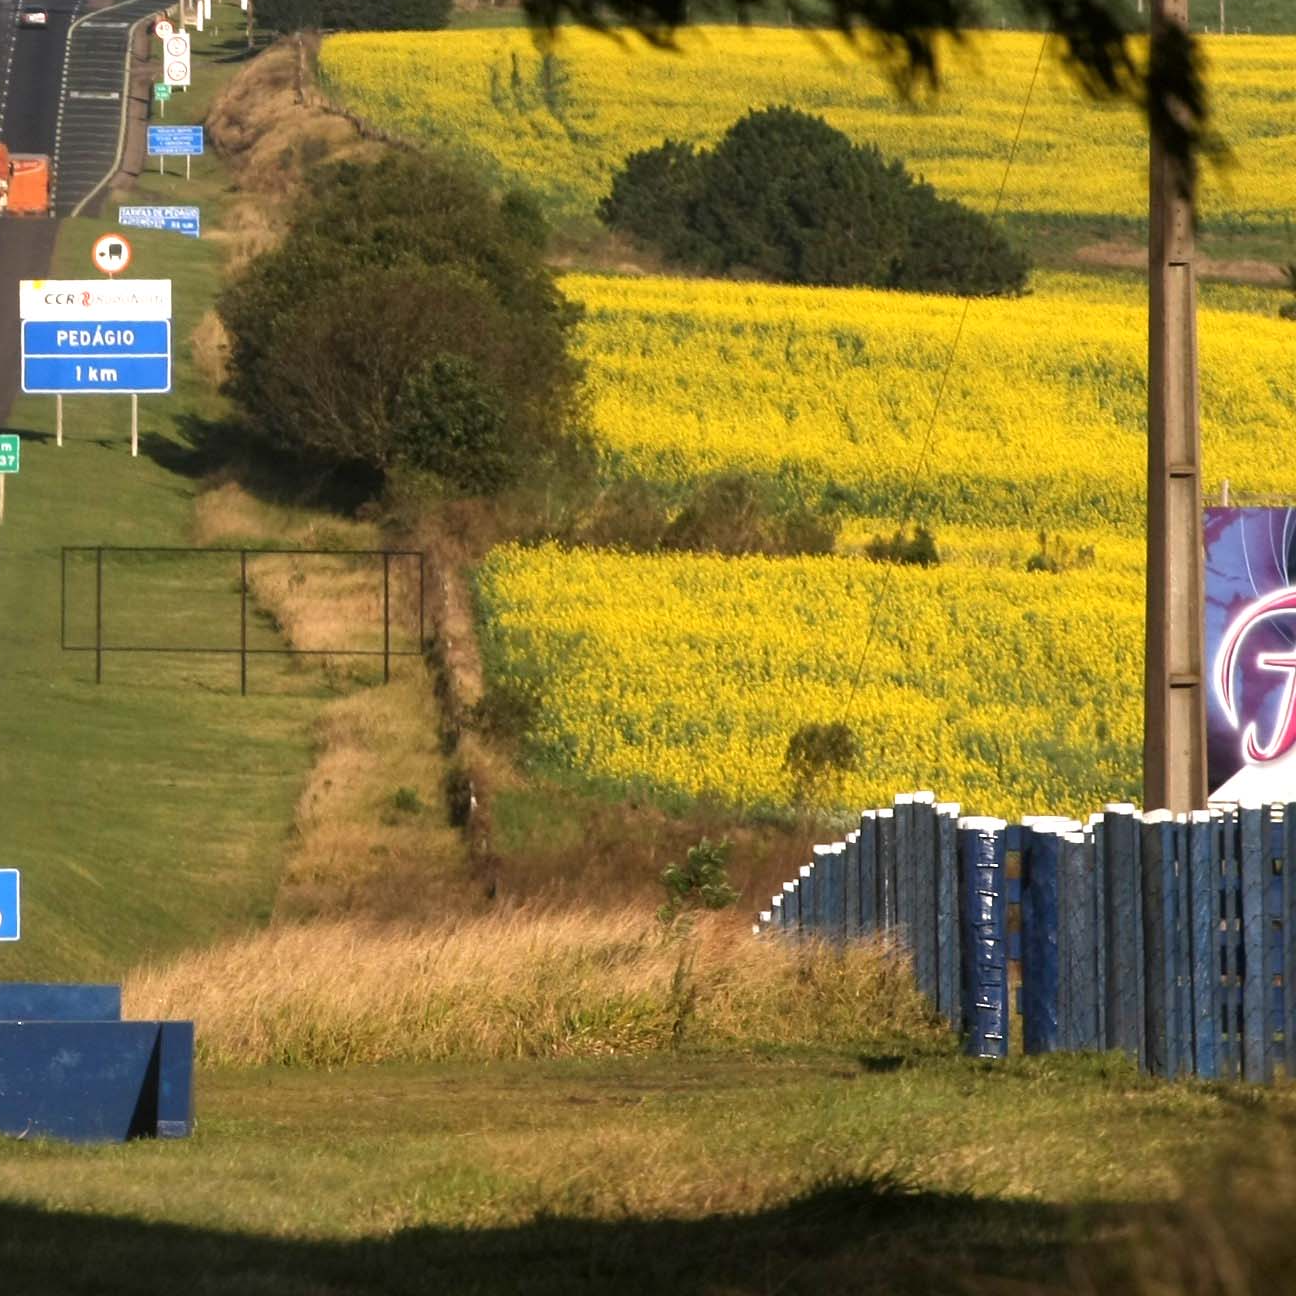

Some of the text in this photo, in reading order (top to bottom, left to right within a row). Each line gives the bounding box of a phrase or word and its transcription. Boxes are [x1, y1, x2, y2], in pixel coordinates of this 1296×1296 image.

[44, 293, 75, 305] CCR
[56, 324, 135, 347] PEDÁGIO
[76, 365, 118, 382] 1 km
